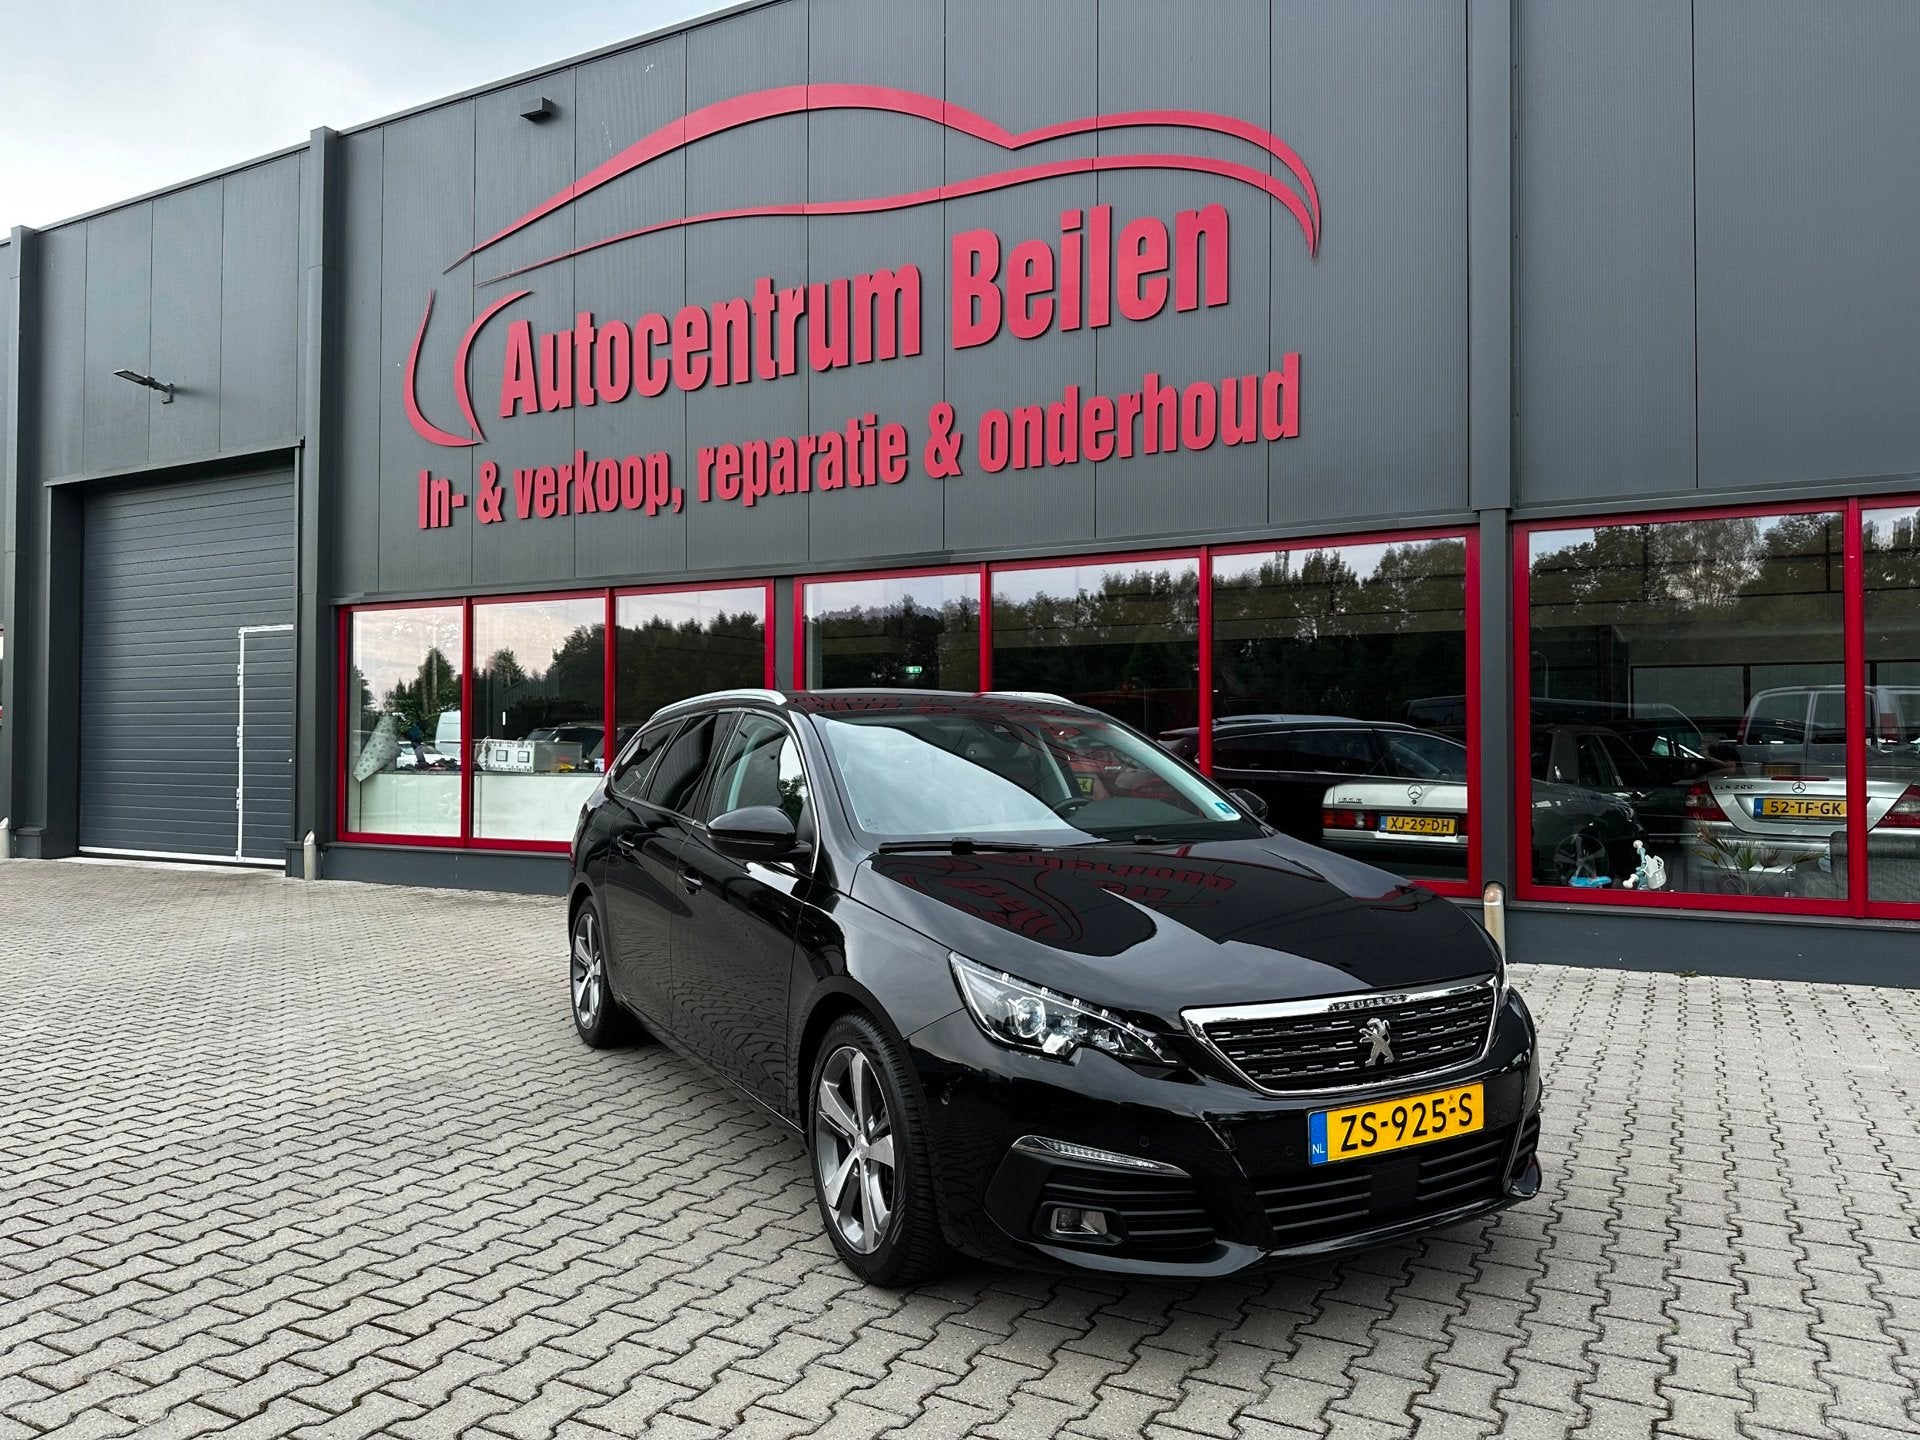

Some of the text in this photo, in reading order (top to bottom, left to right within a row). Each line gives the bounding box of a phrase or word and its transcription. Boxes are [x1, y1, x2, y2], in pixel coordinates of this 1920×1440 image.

[501, 204, 1230, 418] Autocentrum Beilen
[419, 353, 1301, 530] In- & verkoop, reparatie & onderhoud
[1390, 817, 1450, 832] XJ-29-DH
[1770, 801, 1842, 815] 52-TF-GK
[1340, 1092, 1474, 1152] ZS-925-S
[1312, 1143, 1325, 1155] NL
